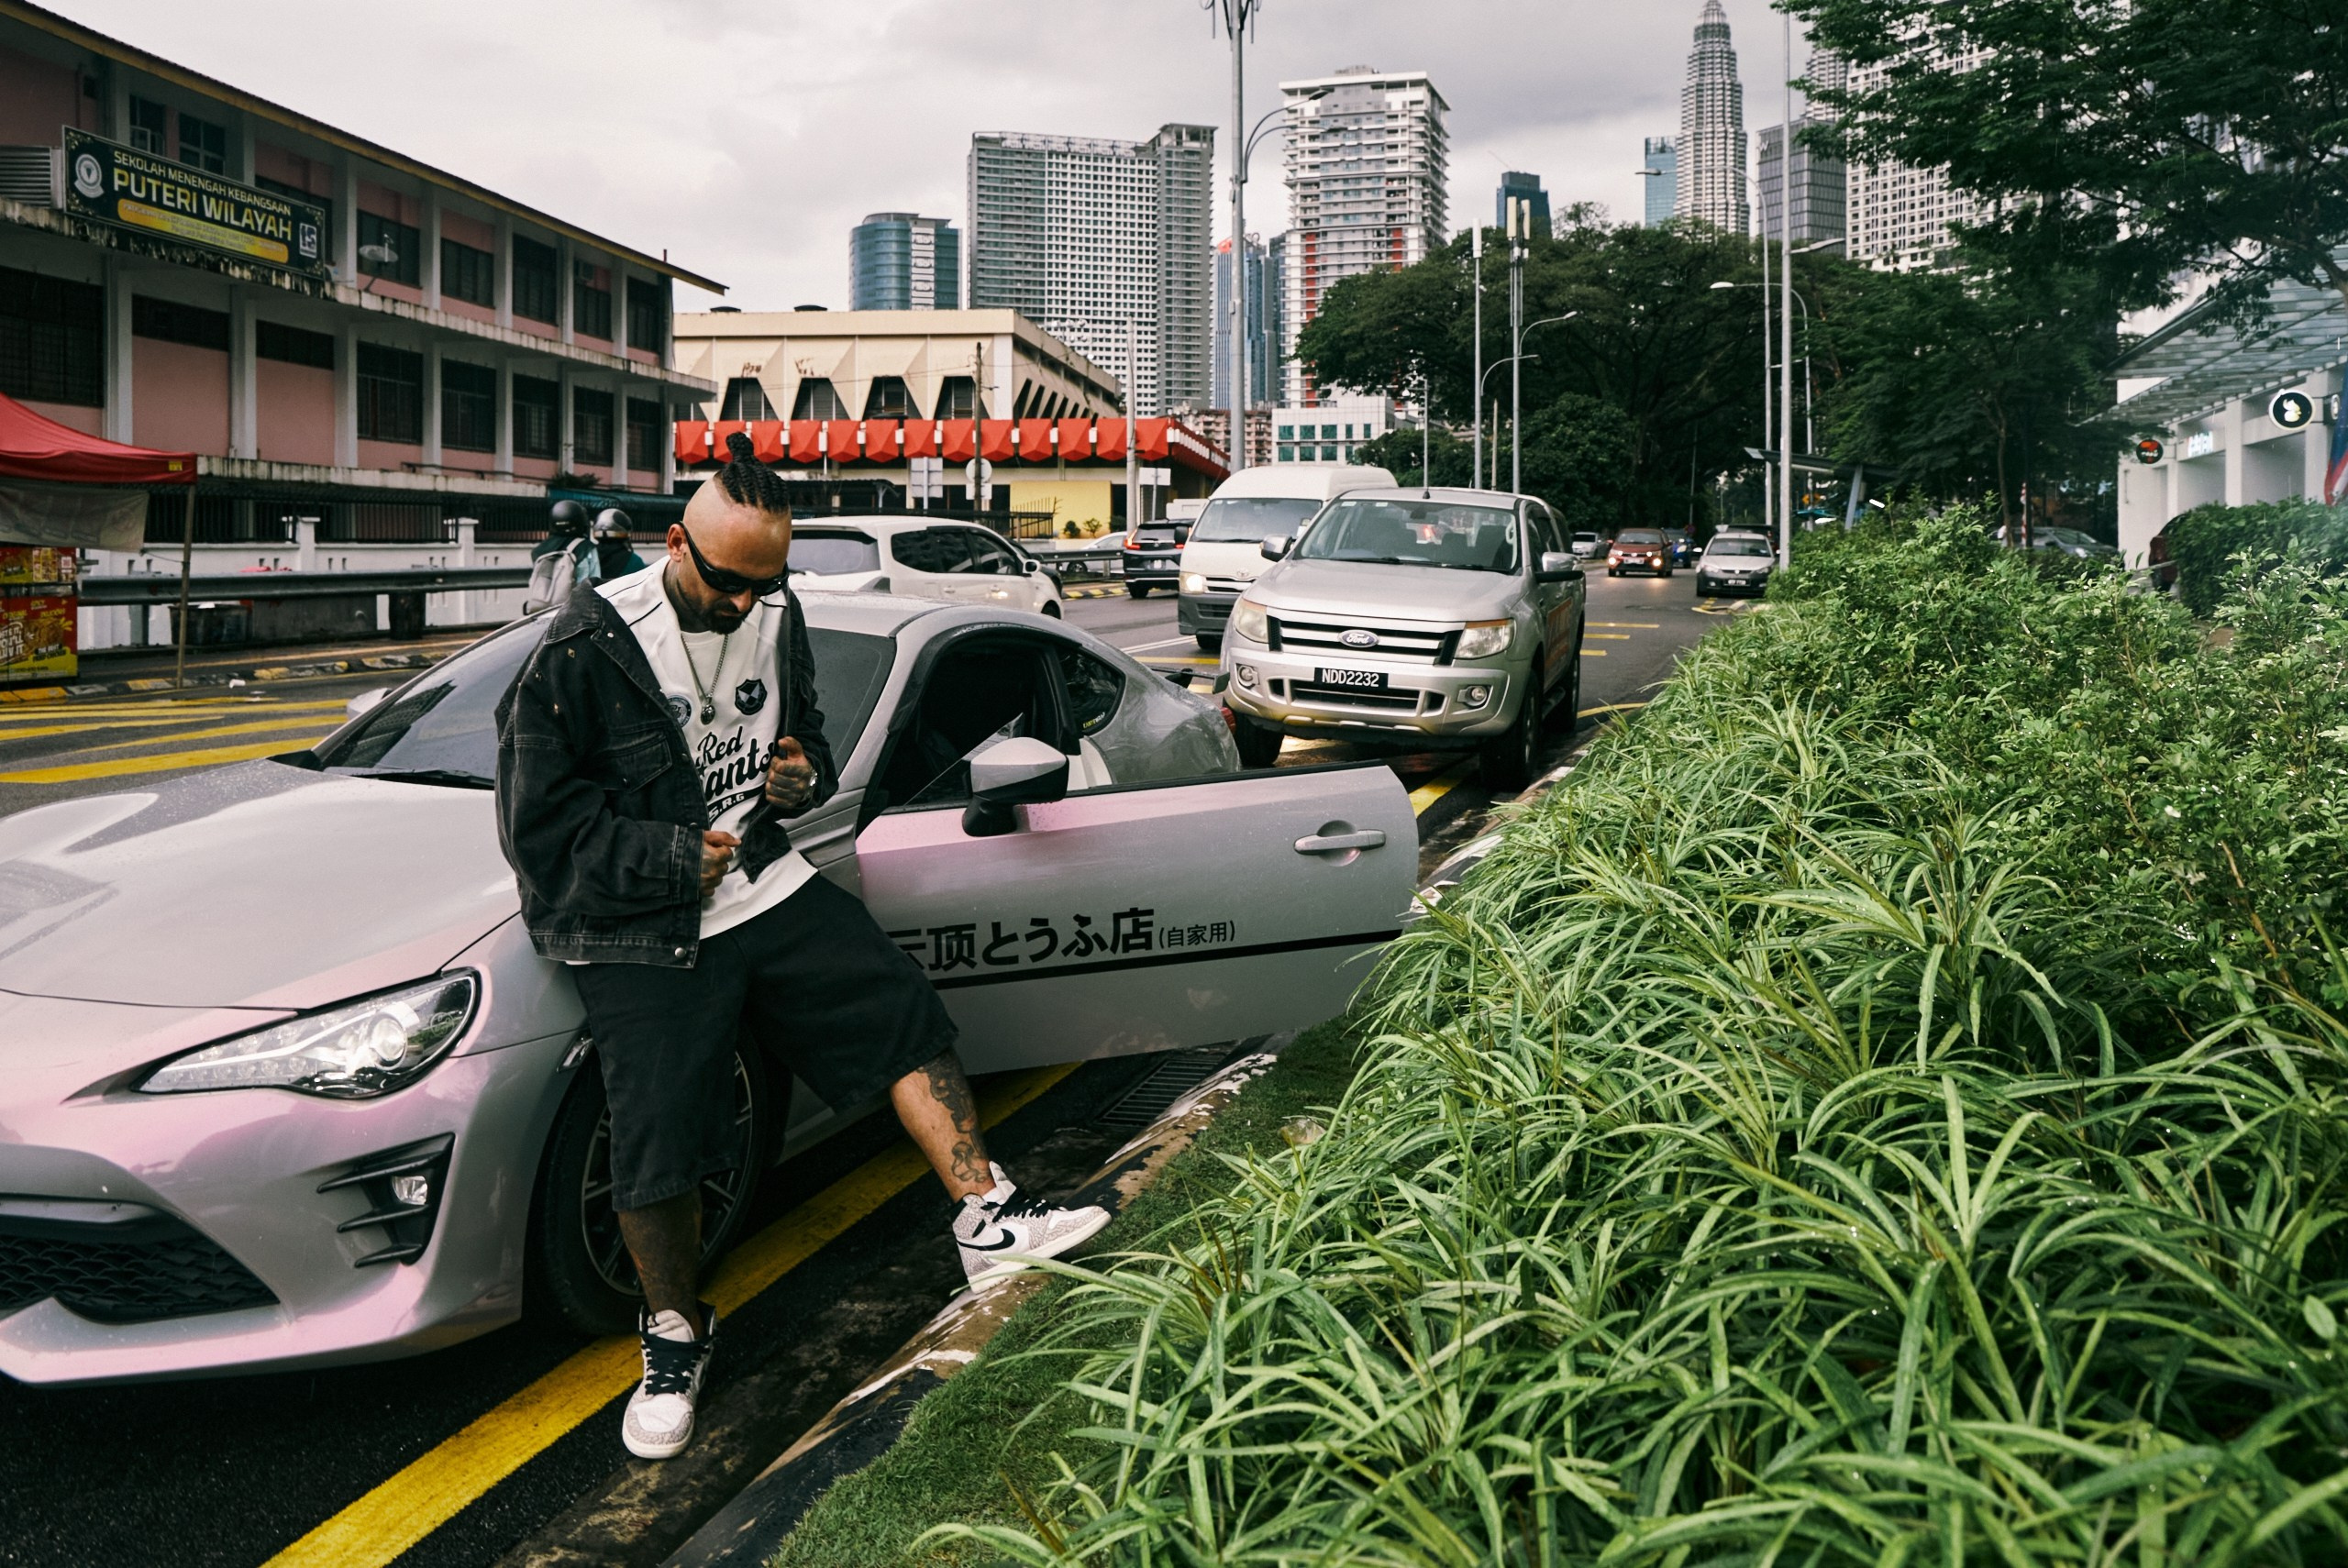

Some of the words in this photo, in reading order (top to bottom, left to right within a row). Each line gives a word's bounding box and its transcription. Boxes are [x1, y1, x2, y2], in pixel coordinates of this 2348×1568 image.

[114, 150, 166, 177] SEKOLAH
[168, 168, 227, 197] MENENGAH
[228, 187, 291, 216] KEBANGSAAN
[114, 168, 197, 215] PUTERI
[203, 194, 292, 241] WILAYAH
[1346, 633, 1370, 644] Ford
[1322, 668, 1379, 688] NDD2232
[696, 738, 774, 802] ants
[698, 725, 744, 765] Red
